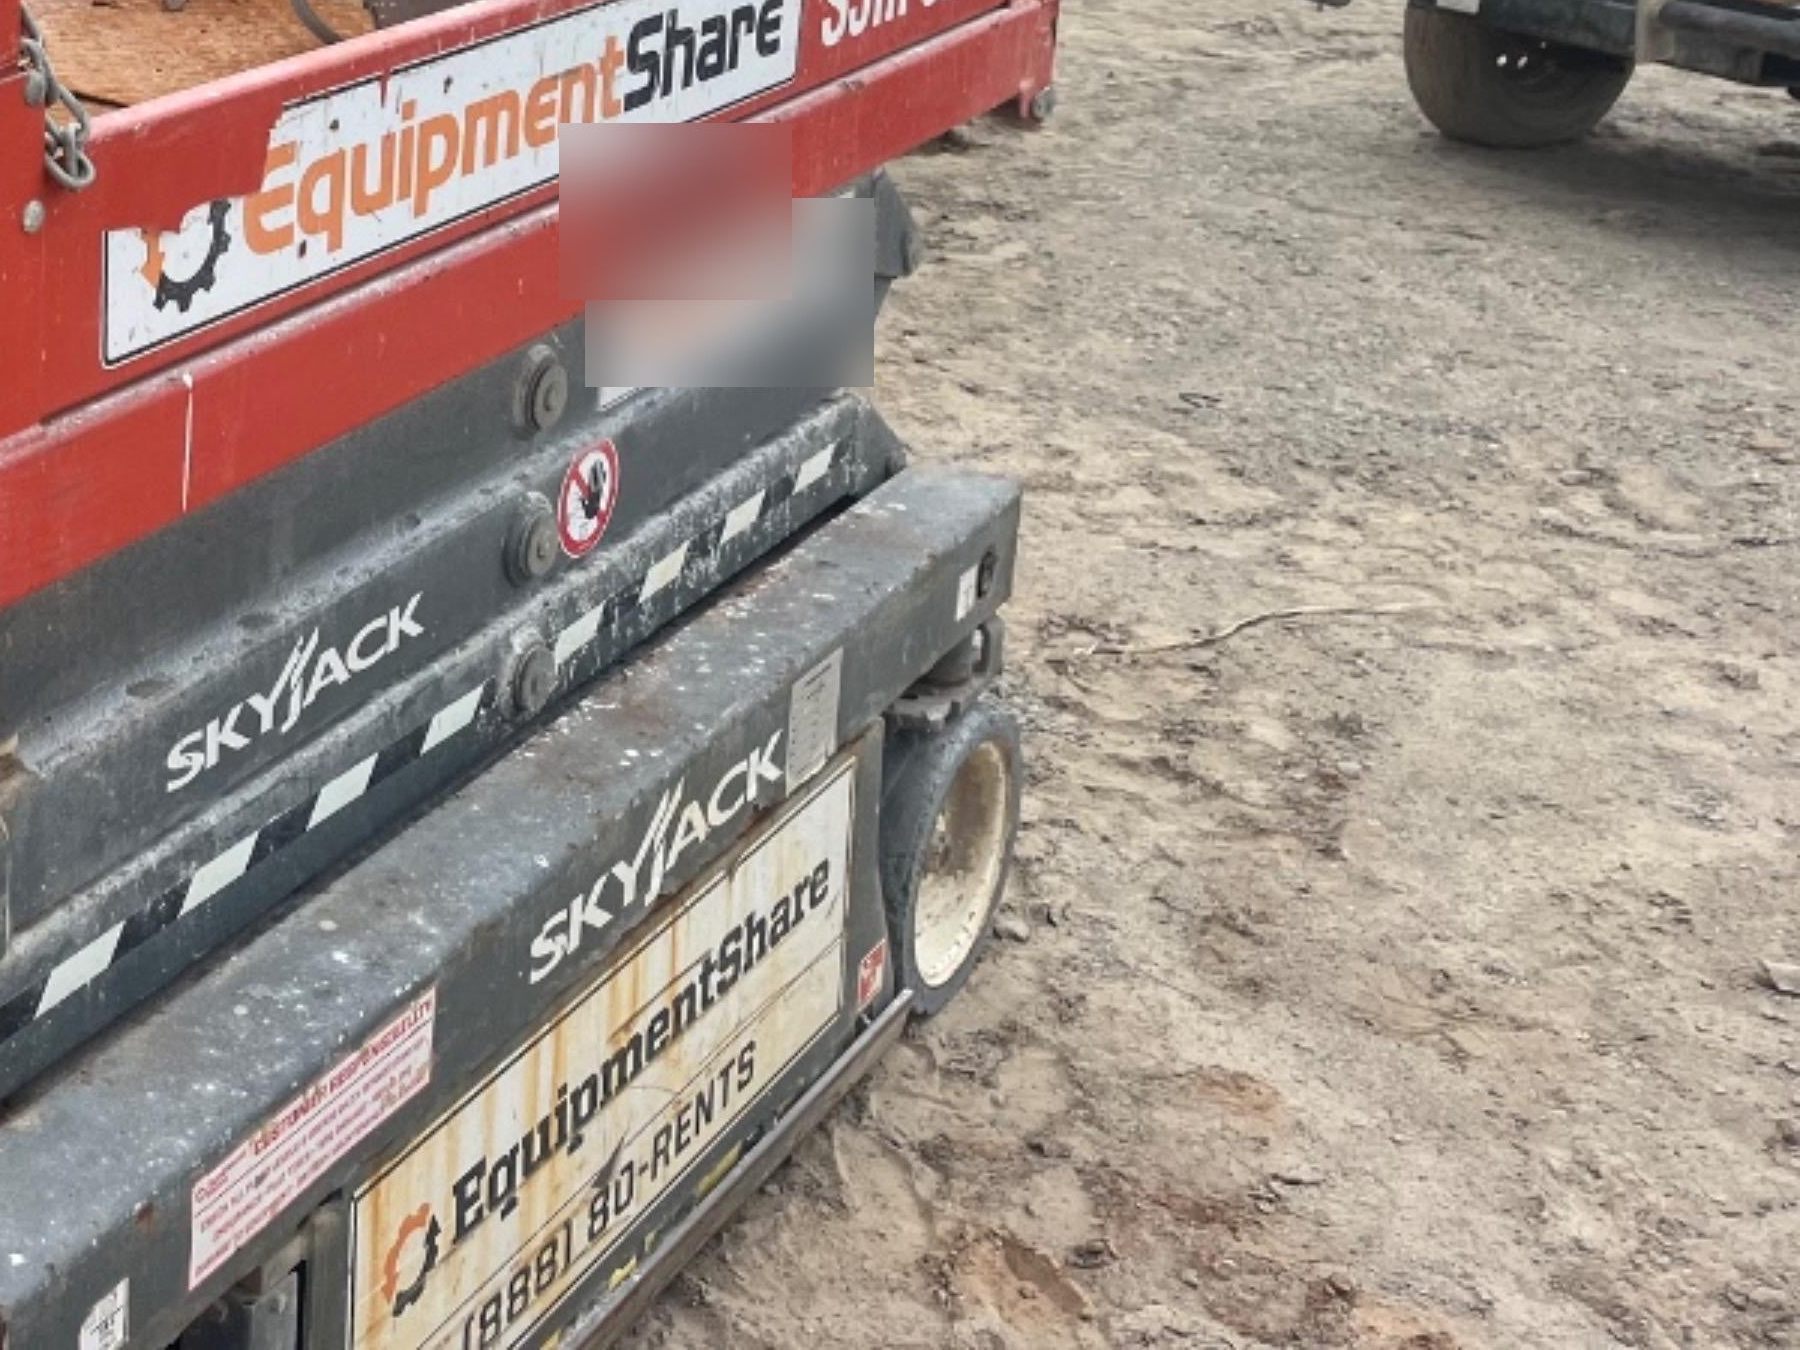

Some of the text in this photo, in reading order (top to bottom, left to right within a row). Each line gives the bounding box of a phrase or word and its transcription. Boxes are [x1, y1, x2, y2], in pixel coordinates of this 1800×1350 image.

[166, 591, 425, 792] SKYJACK
[529, 729, 783, 985] SKYJACK
[452, 856, 830, 1245] EquipmentShare
[587, 1038, 758, 1243] 80-RENTS
